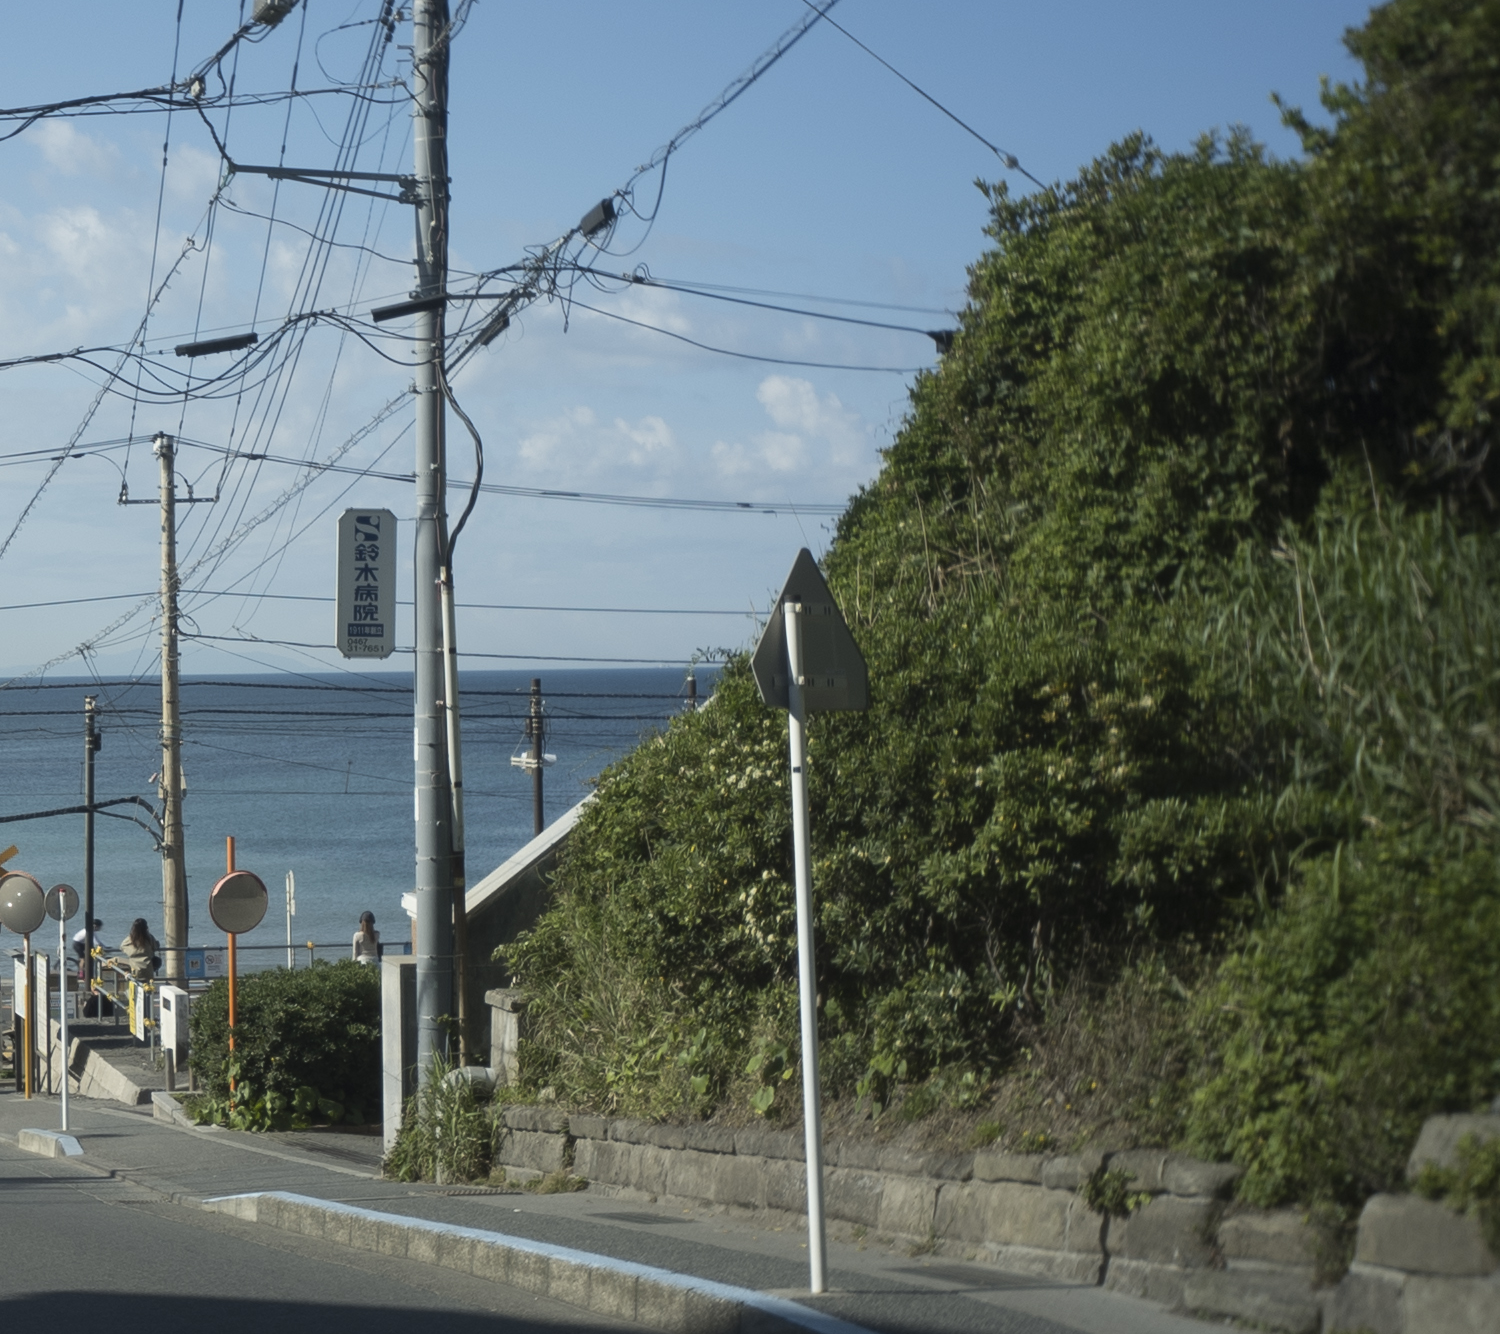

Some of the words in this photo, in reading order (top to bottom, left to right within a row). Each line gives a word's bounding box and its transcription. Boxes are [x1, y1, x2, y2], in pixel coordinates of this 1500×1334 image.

[353, 543, 380, 622] 鈴木病院
[347, 645, 384, 653] 31-7651
